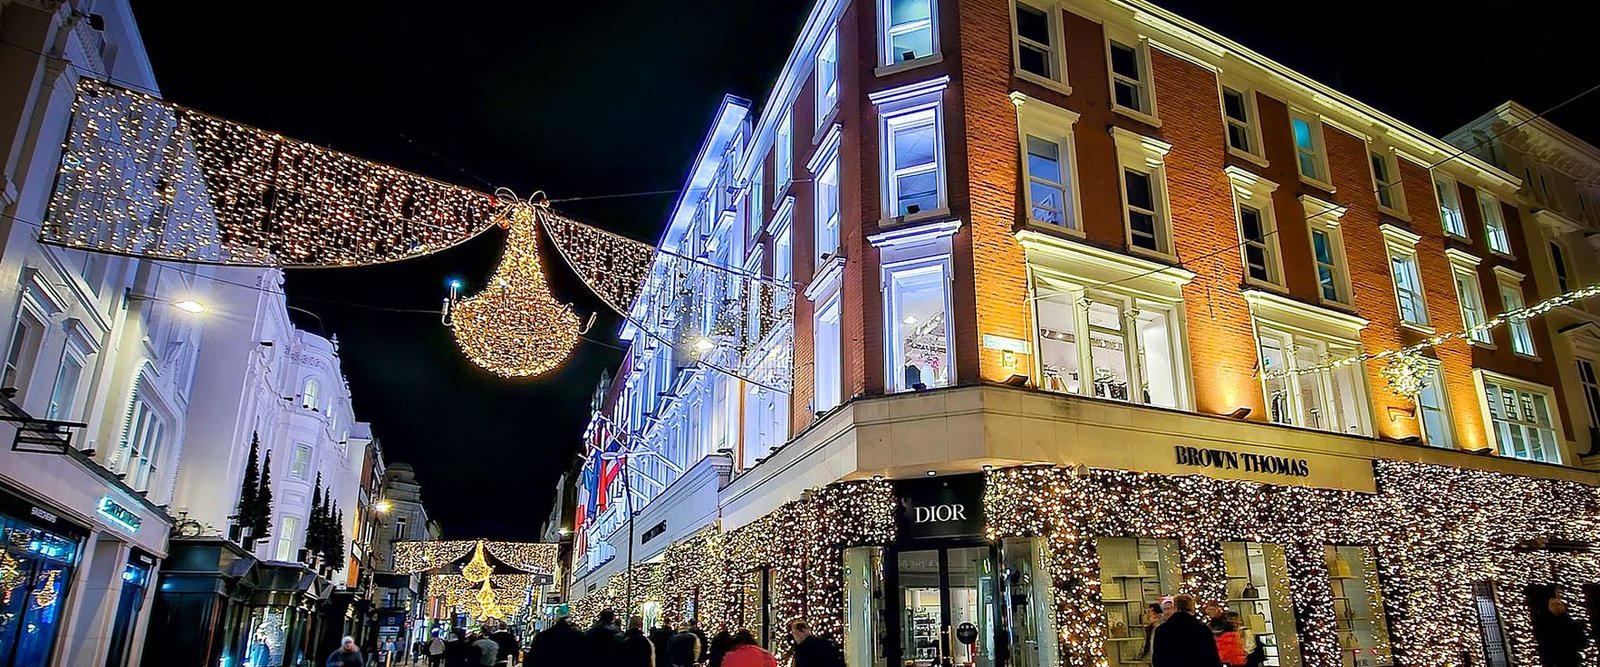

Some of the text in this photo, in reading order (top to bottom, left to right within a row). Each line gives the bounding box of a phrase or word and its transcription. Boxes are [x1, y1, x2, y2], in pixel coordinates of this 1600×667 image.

[1174, 445, 1309, 477] BROWN THOMAS
[913, 503, 967, 523] DIOR
